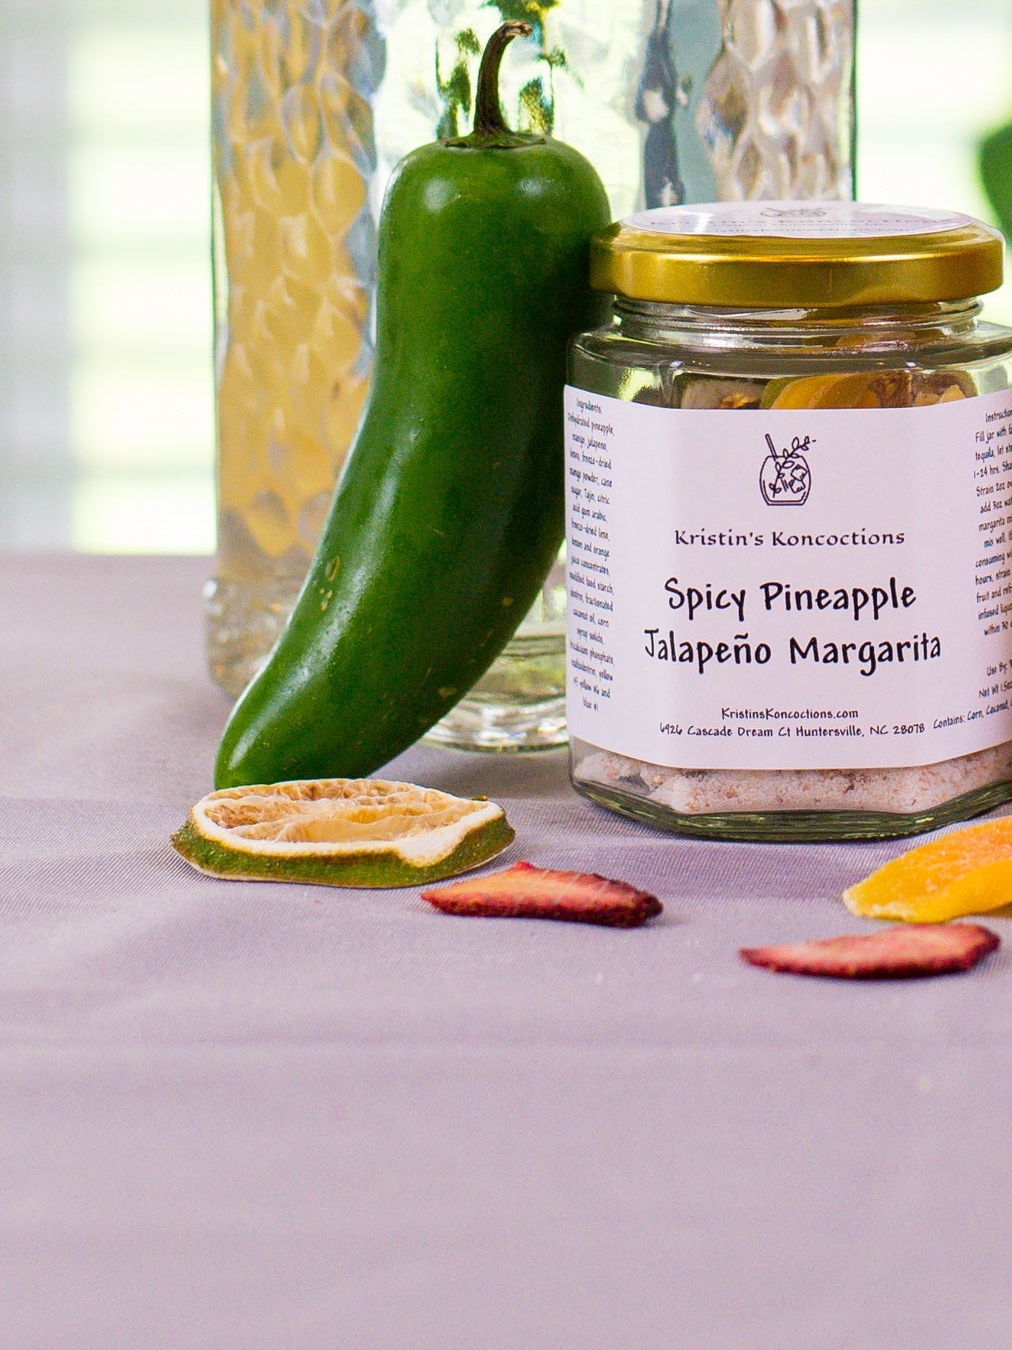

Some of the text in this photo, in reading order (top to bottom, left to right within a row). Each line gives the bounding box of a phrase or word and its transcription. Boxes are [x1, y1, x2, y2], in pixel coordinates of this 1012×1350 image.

[976, 431, 985, 443] Fill
[986, 431, 994, 443] jar
[976, 484, 994, 497] Strain
[980, 501, 991, 513] add
[675, 528, 905, 546] Kristin's Koncoctions
[664, 577, 916, 621] Spicy Pineapple
[644, 628, 941, 676] Jalapeño Margarita
[979, 687, 989, 697] Net
[721, 708, 858, 720] KristinsKoncoctions.com
[934, 716, 965, 729] Contains:
[688, 726, 732, 736] Cascade
[738, 727, 773, 737] Dream
[778, 726, 790, 737] Ct
[796, 726, 865, 737] Huntersville,
[869, 726, 888, 734] NC
[893, 724, 925, 734] 28078
